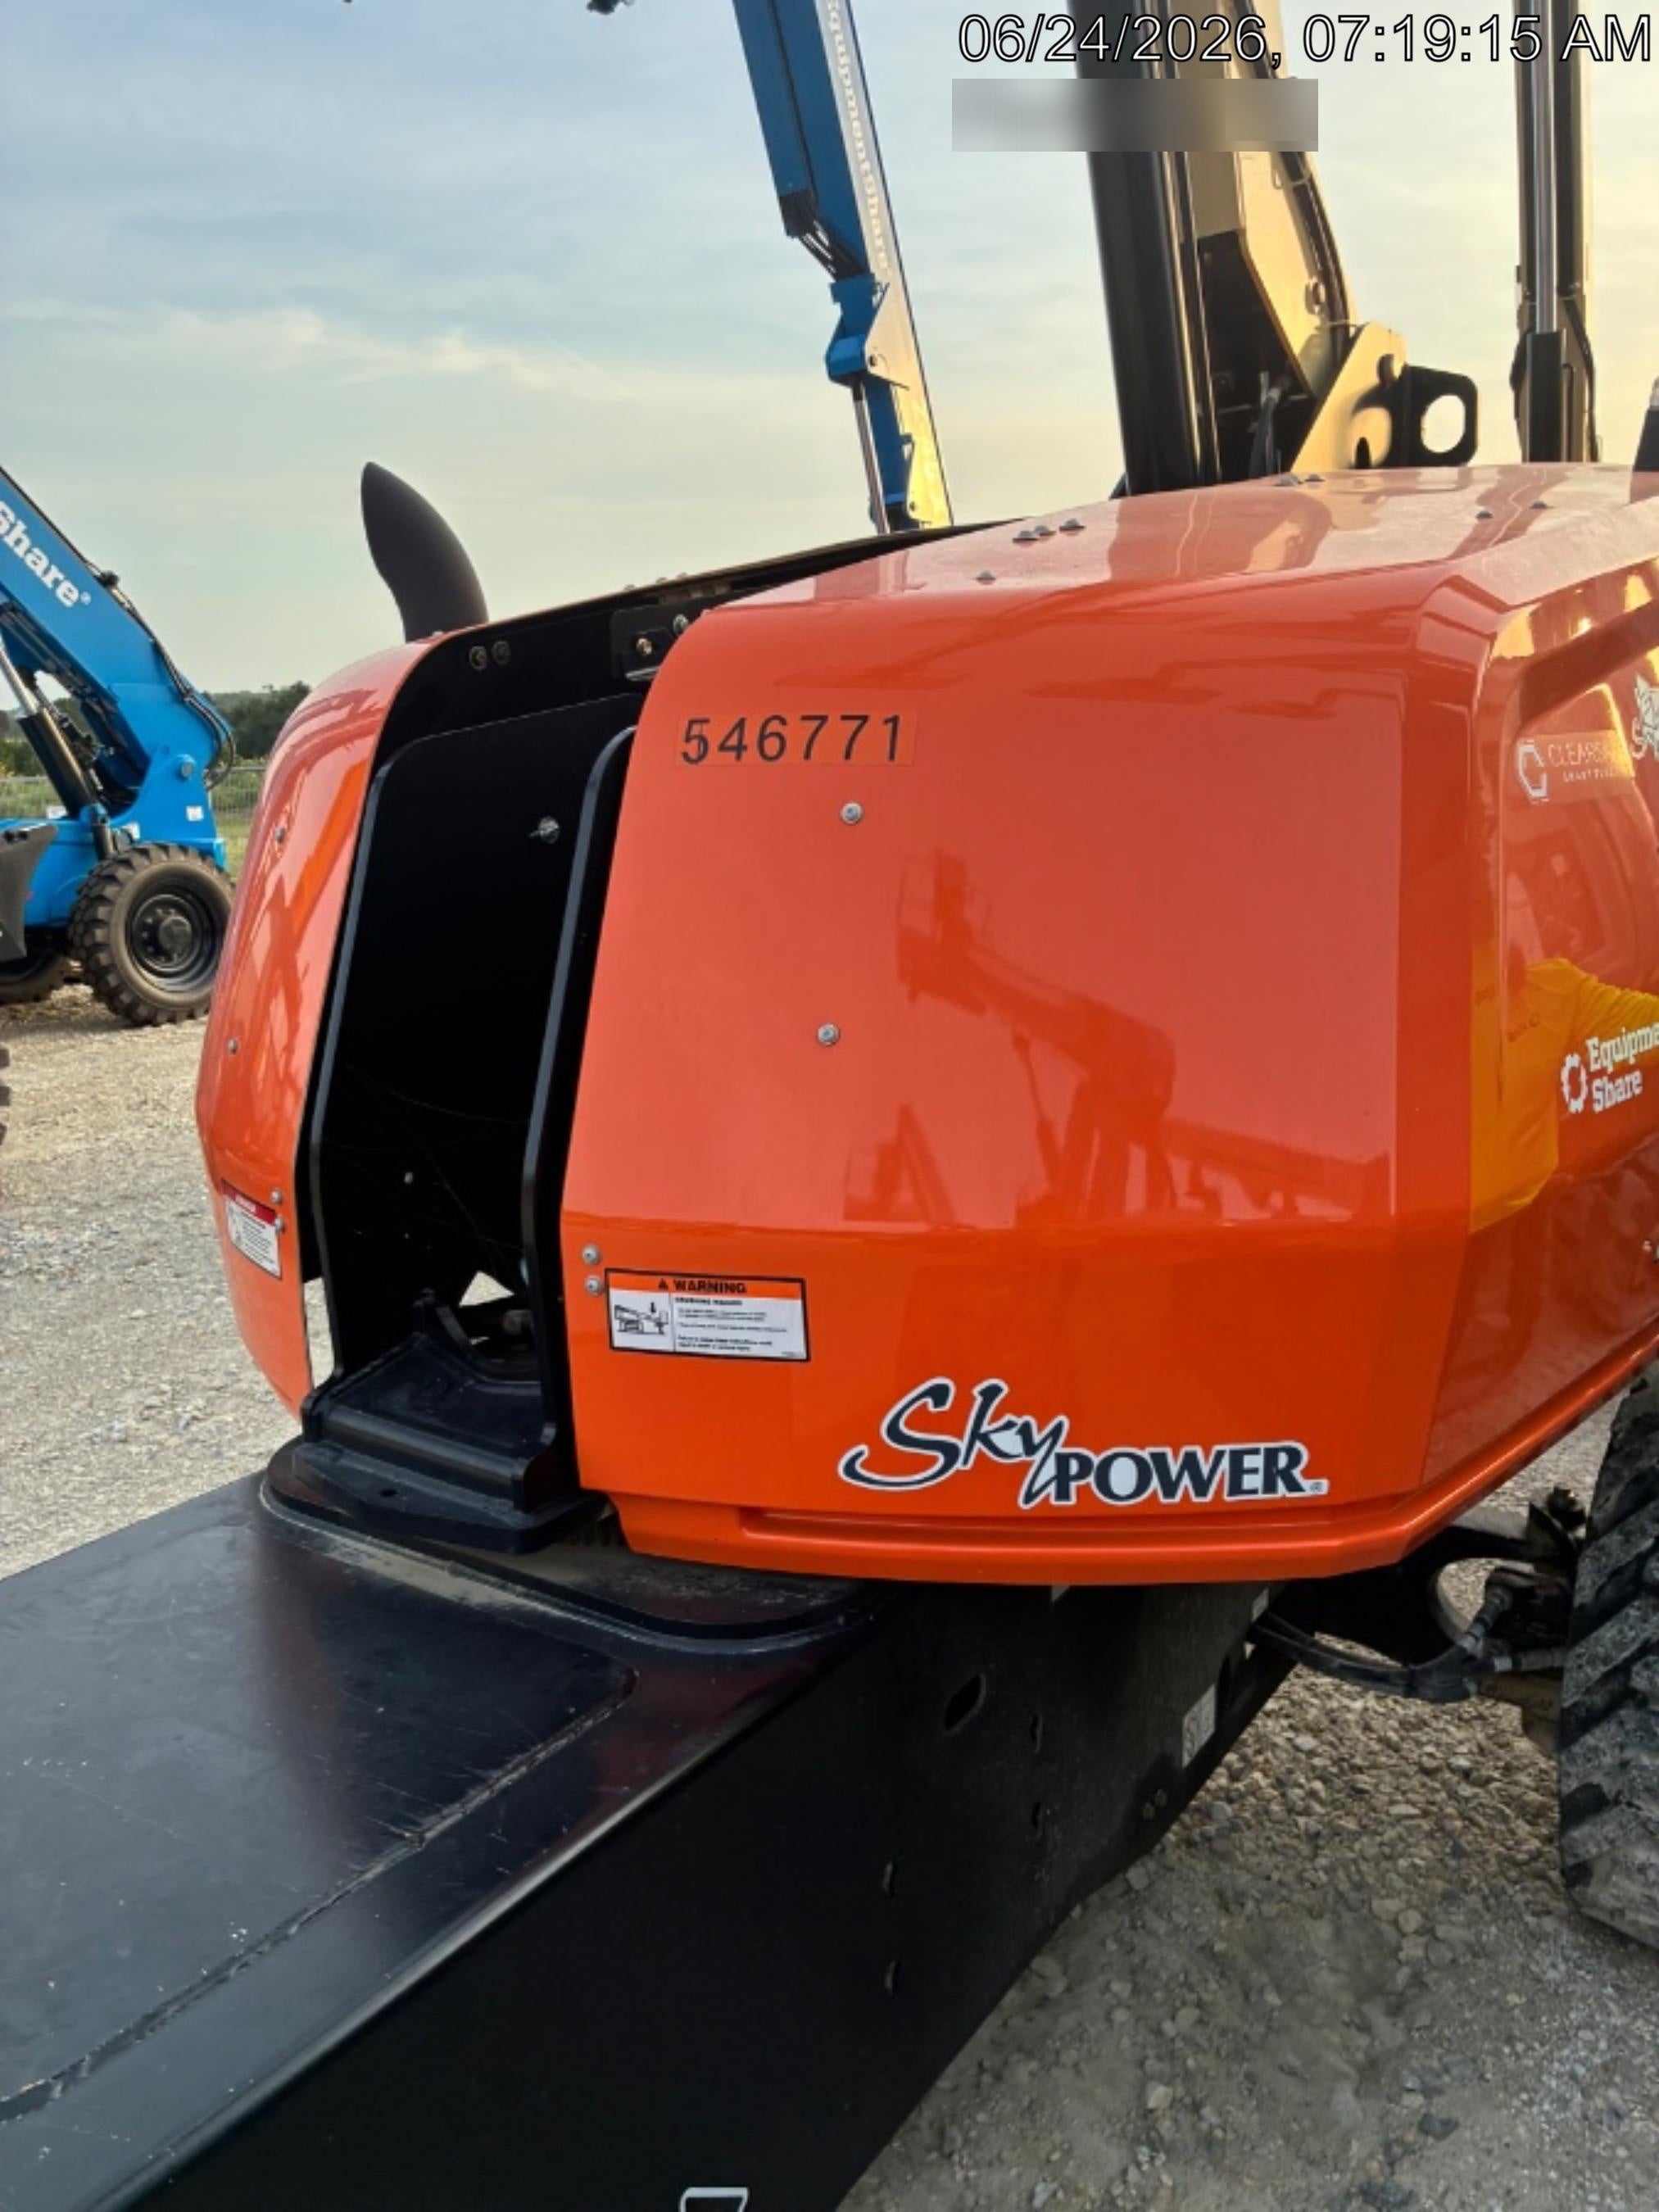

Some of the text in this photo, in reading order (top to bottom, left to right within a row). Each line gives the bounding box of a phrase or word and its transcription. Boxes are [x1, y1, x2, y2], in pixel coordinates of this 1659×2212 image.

[681, 714, 900, 764] 546771
[1593, 1069, 1643, 1113] Share
[673, 1279, 746, 1294] WARNING
